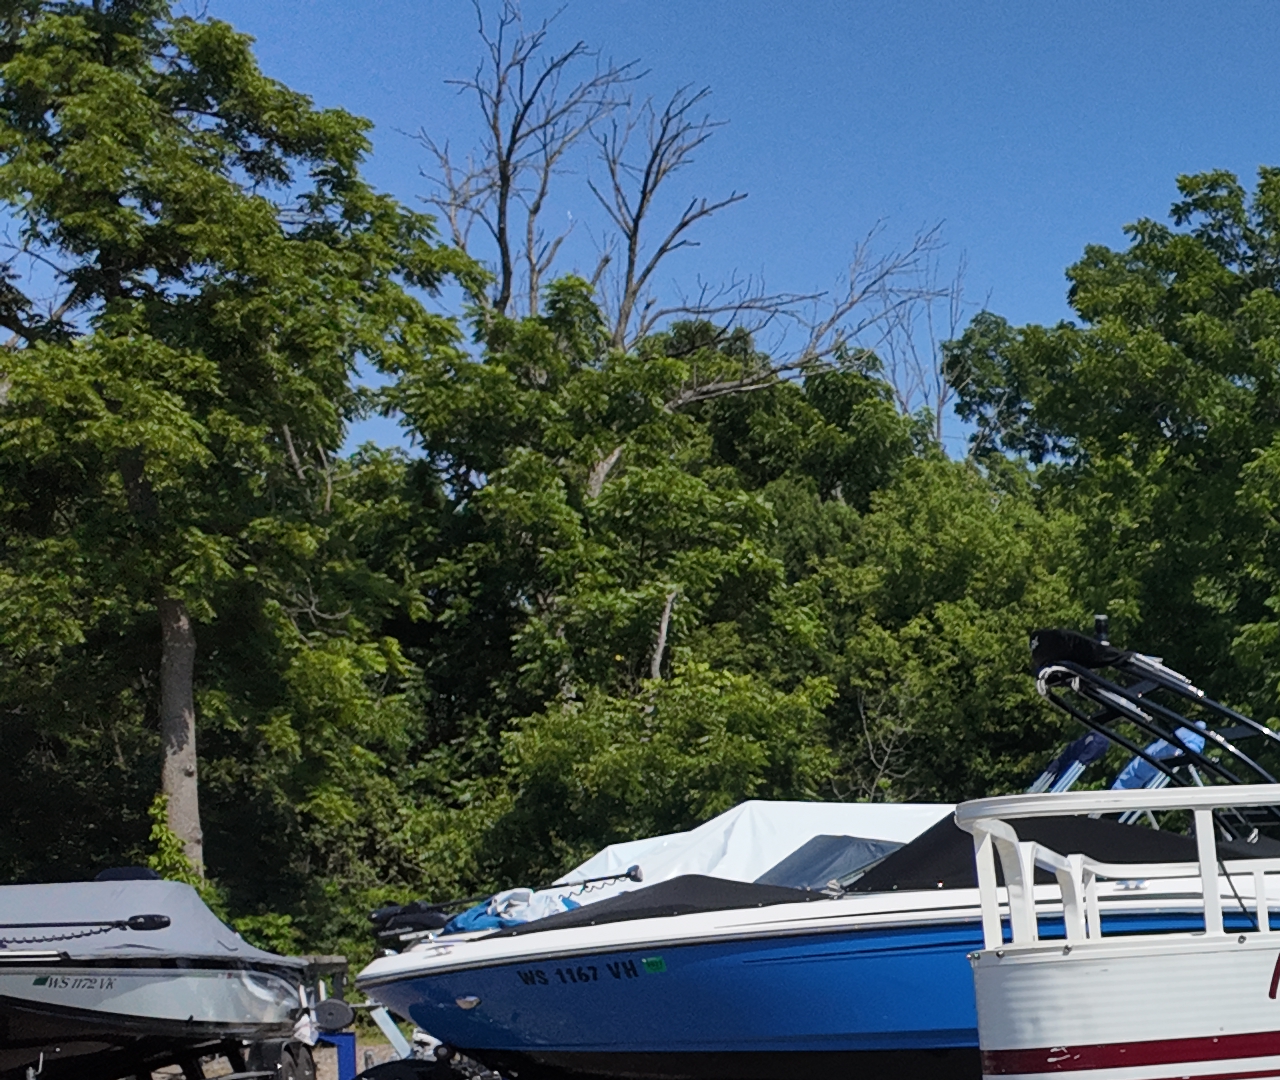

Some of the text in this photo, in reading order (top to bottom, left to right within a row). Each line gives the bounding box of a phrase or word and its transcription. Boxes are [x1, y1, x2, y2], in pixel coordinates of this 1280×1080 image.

[517, 969, 548, 985] WS
[556, 965, 599, 984] 1167
[606, 959, 639, 979] VH
[48, 976, 71, 989] WS
